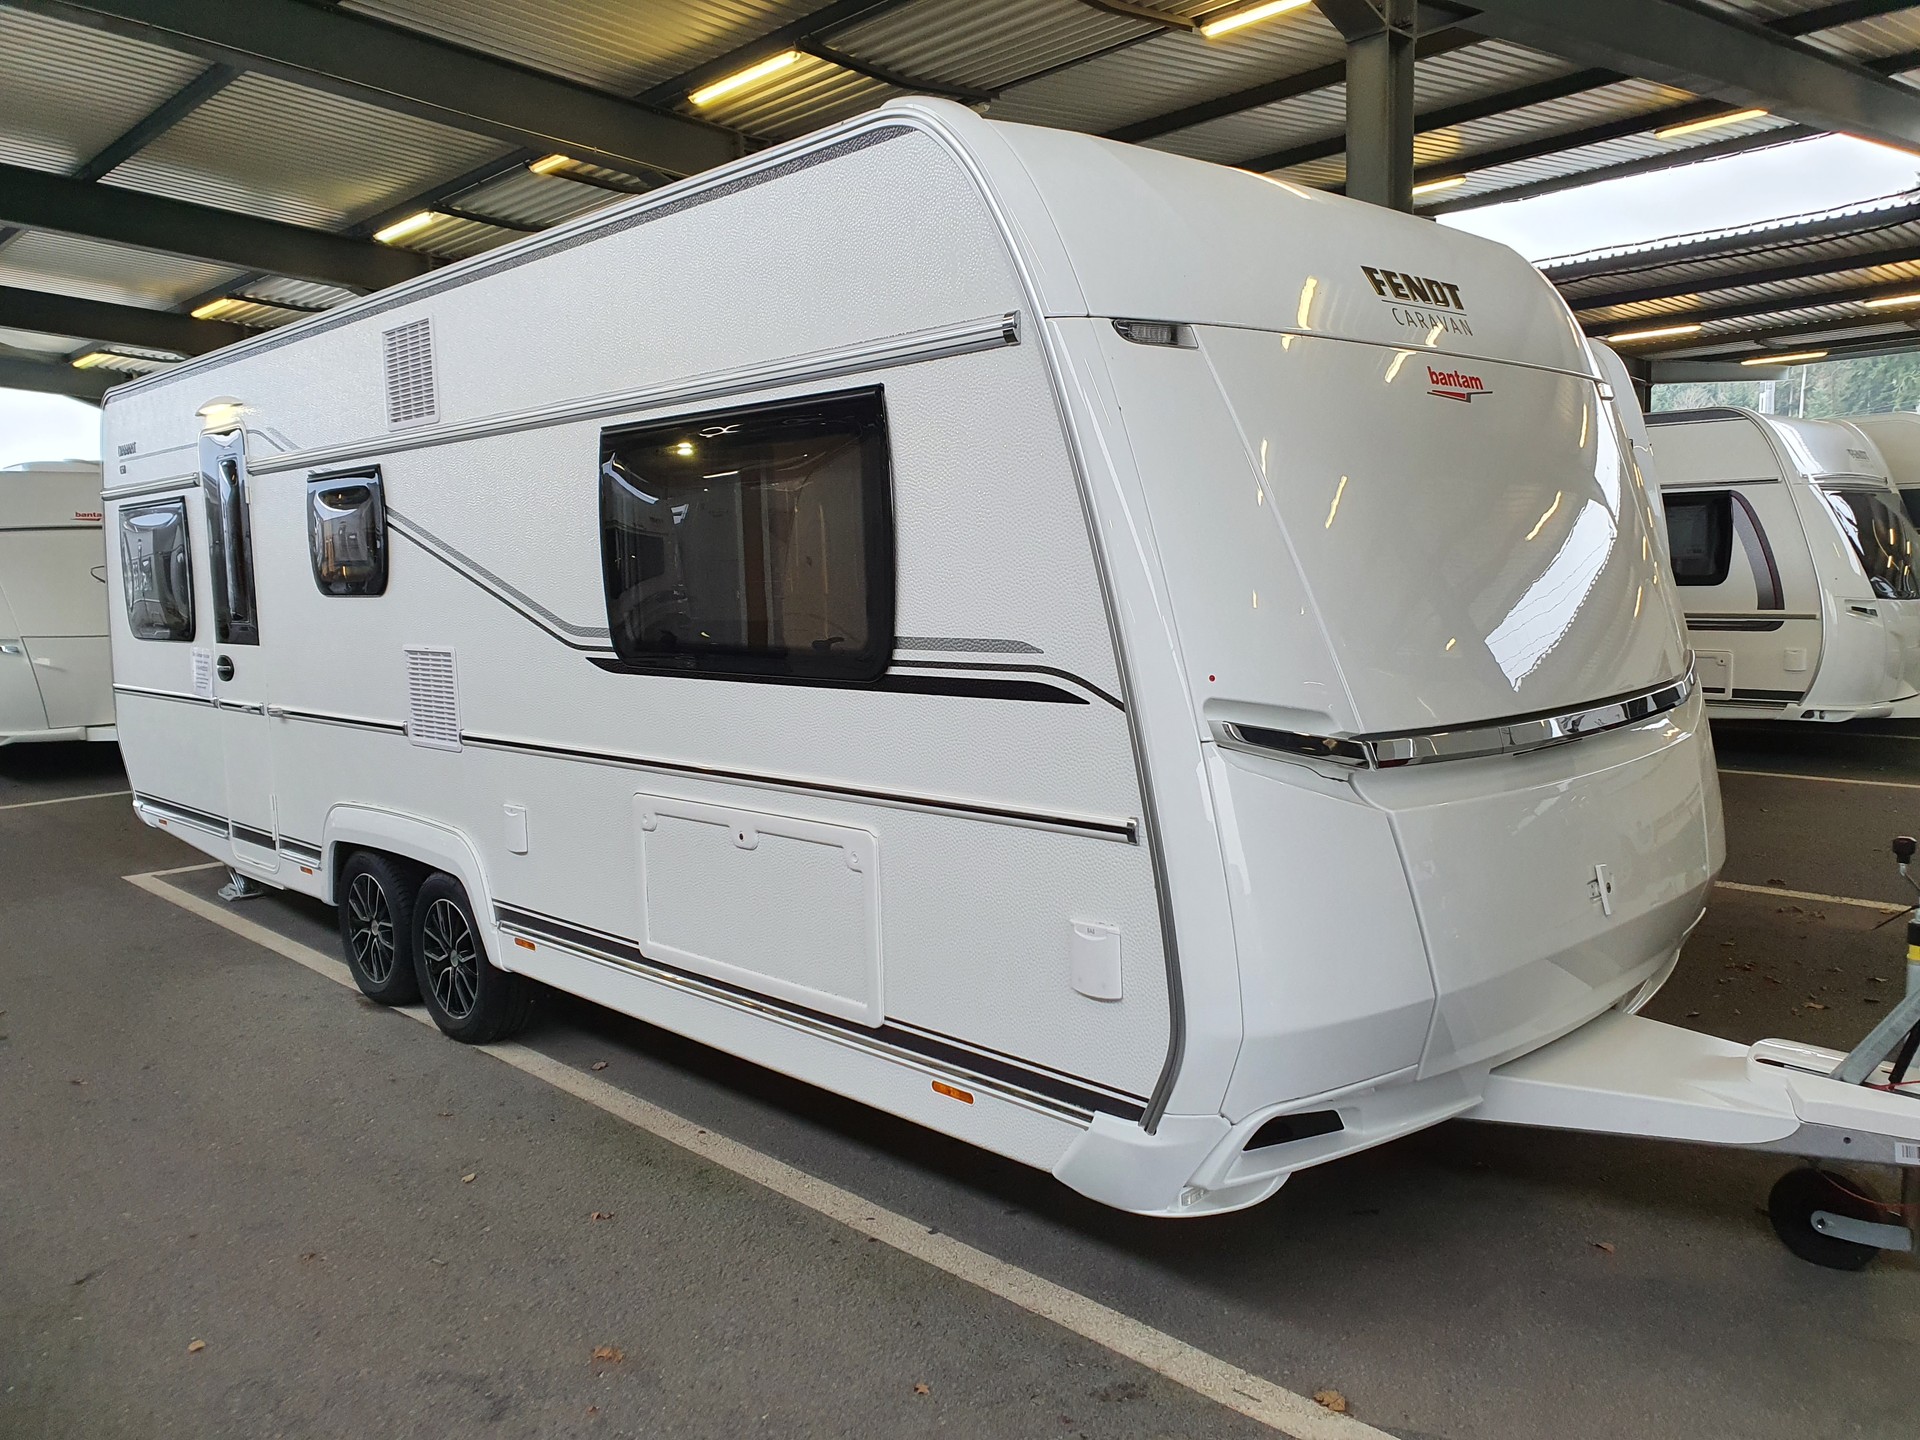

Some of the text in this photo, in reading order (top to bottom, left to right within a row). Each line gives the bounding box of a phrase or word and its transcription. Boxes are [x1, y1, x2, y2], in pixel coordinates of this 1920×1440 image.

[1361, 265, 1464, 310] FENDT
[1391, 307, 1473, 336] CARAVAN
[1427, 366, 1484, 390] bantam
